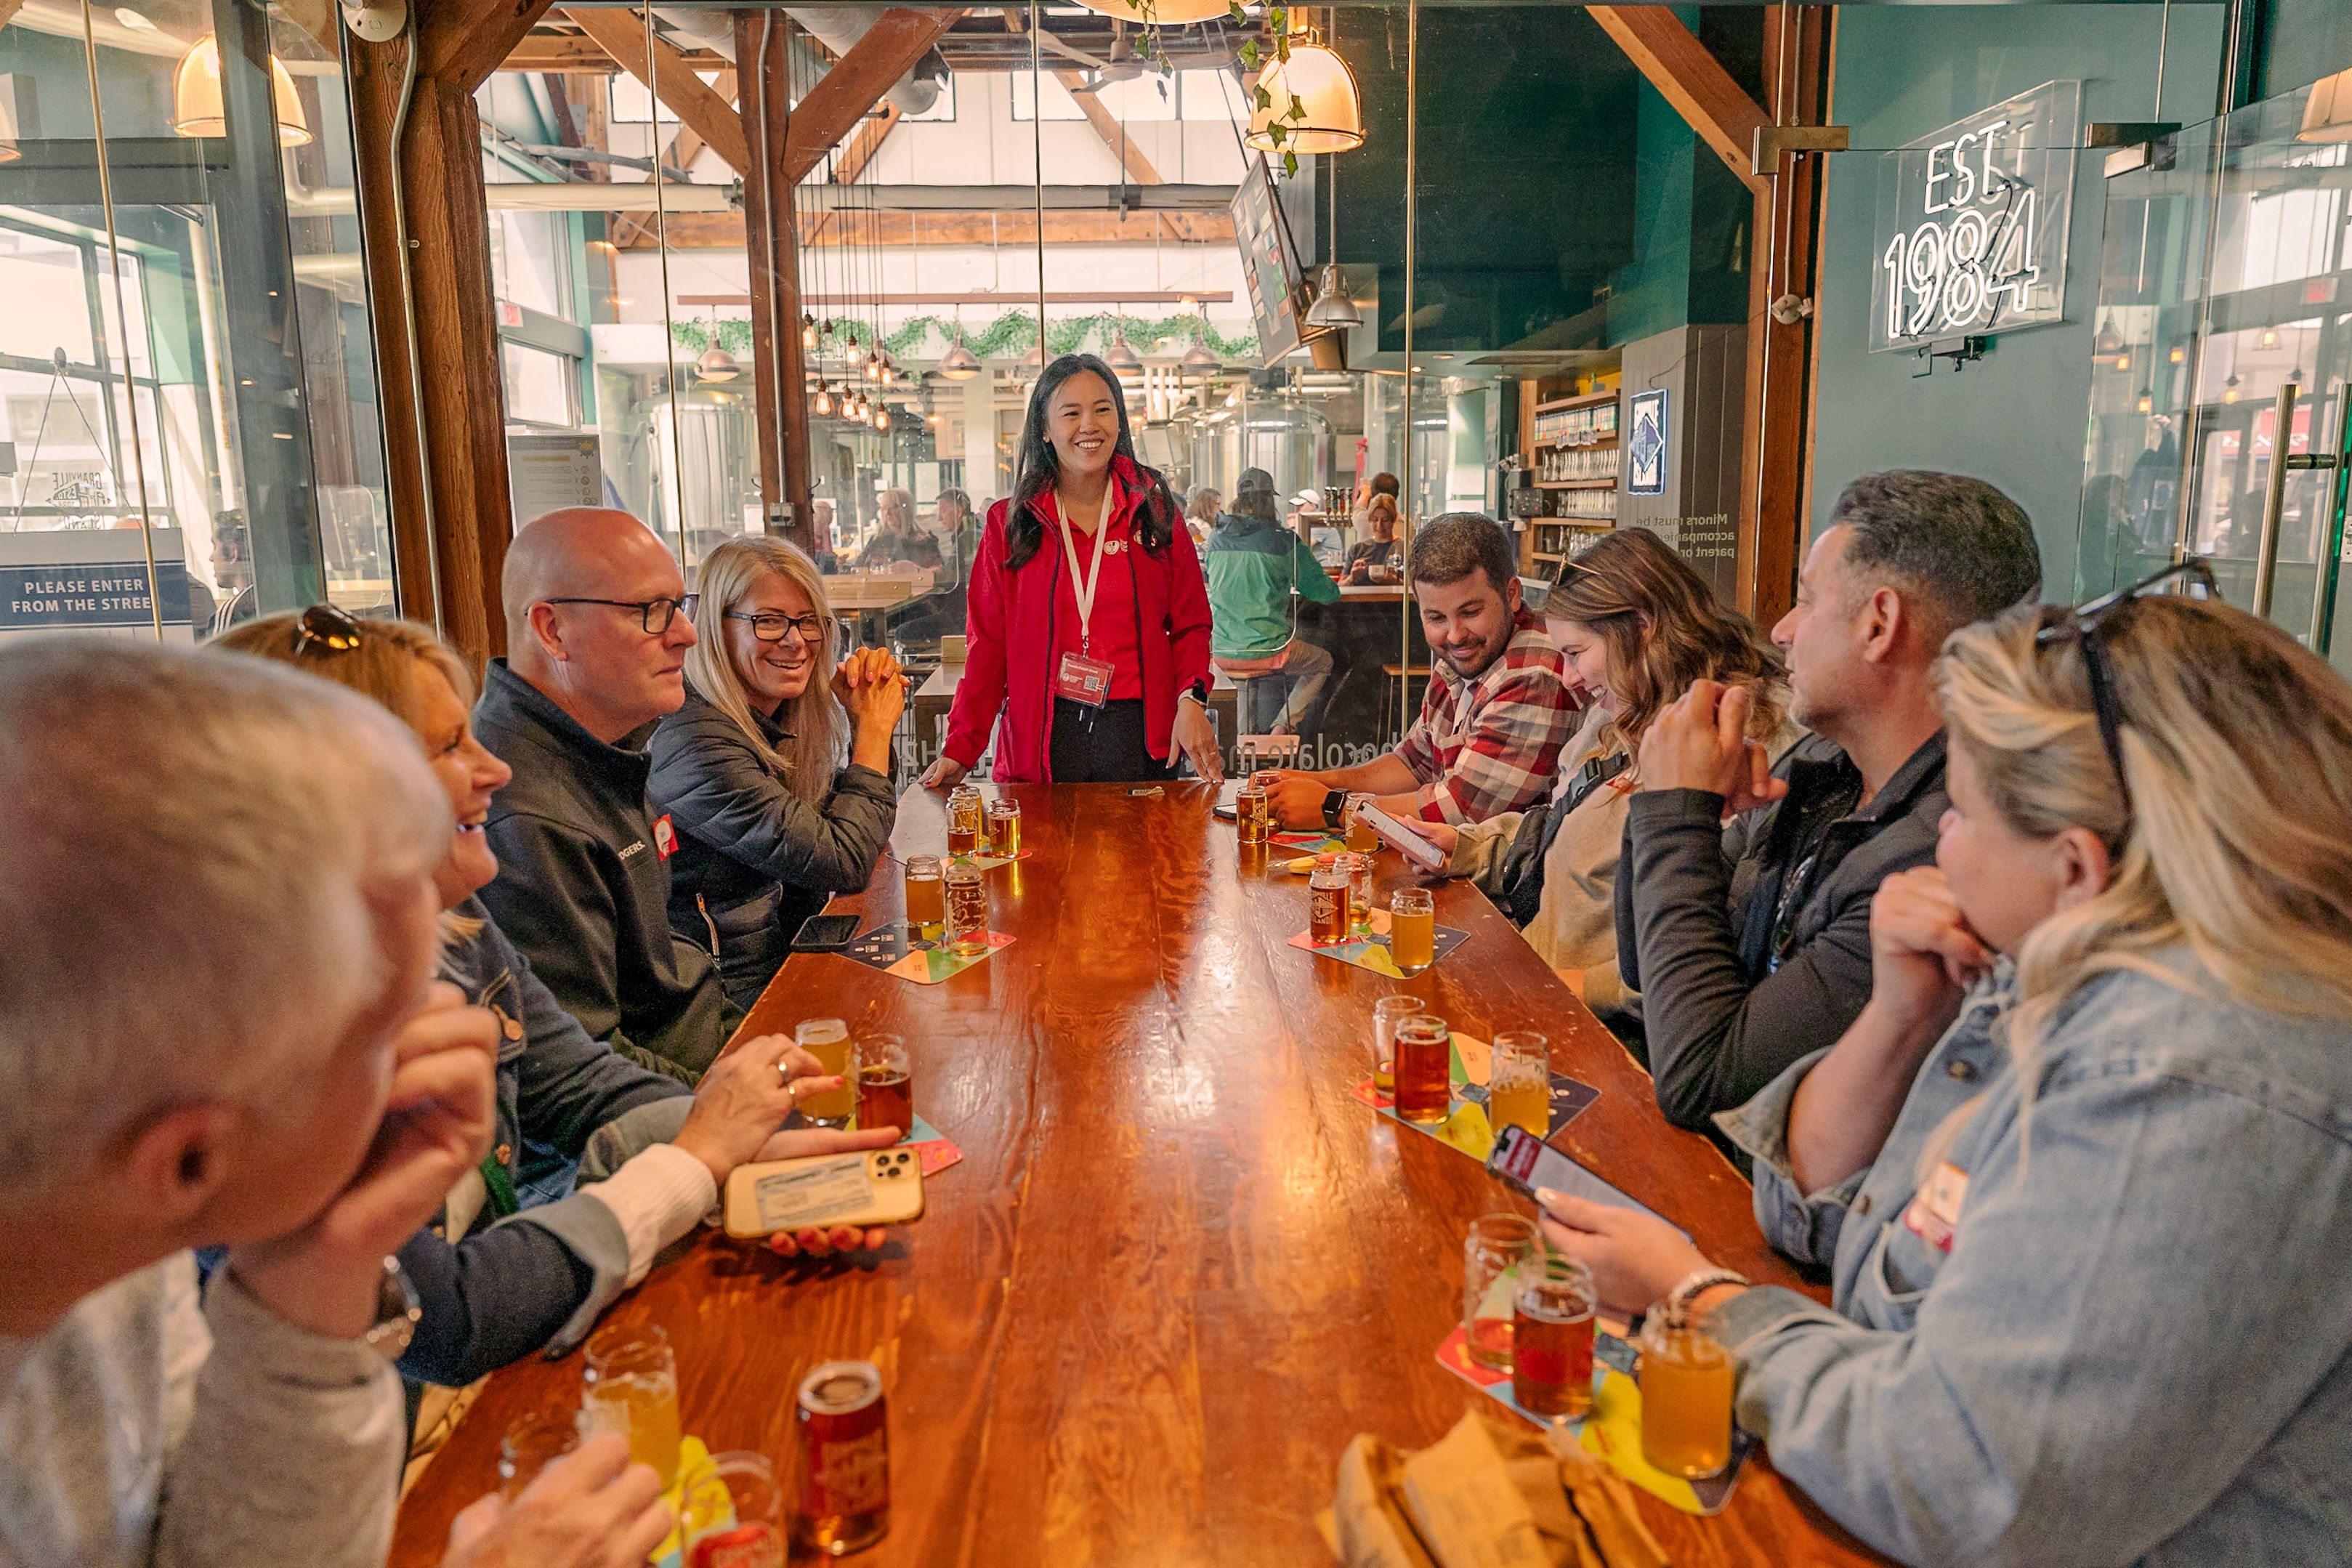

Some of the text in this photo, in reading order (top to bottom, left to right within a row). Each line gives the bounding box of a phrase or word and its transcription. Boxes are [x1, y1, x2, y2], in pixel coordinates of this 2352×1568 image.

[1883, 187, 2040, 339] 1984
[24, 578, 144, 594] PLEASE ENTER
[12, 597, 153, 613] FROM THE STREE
